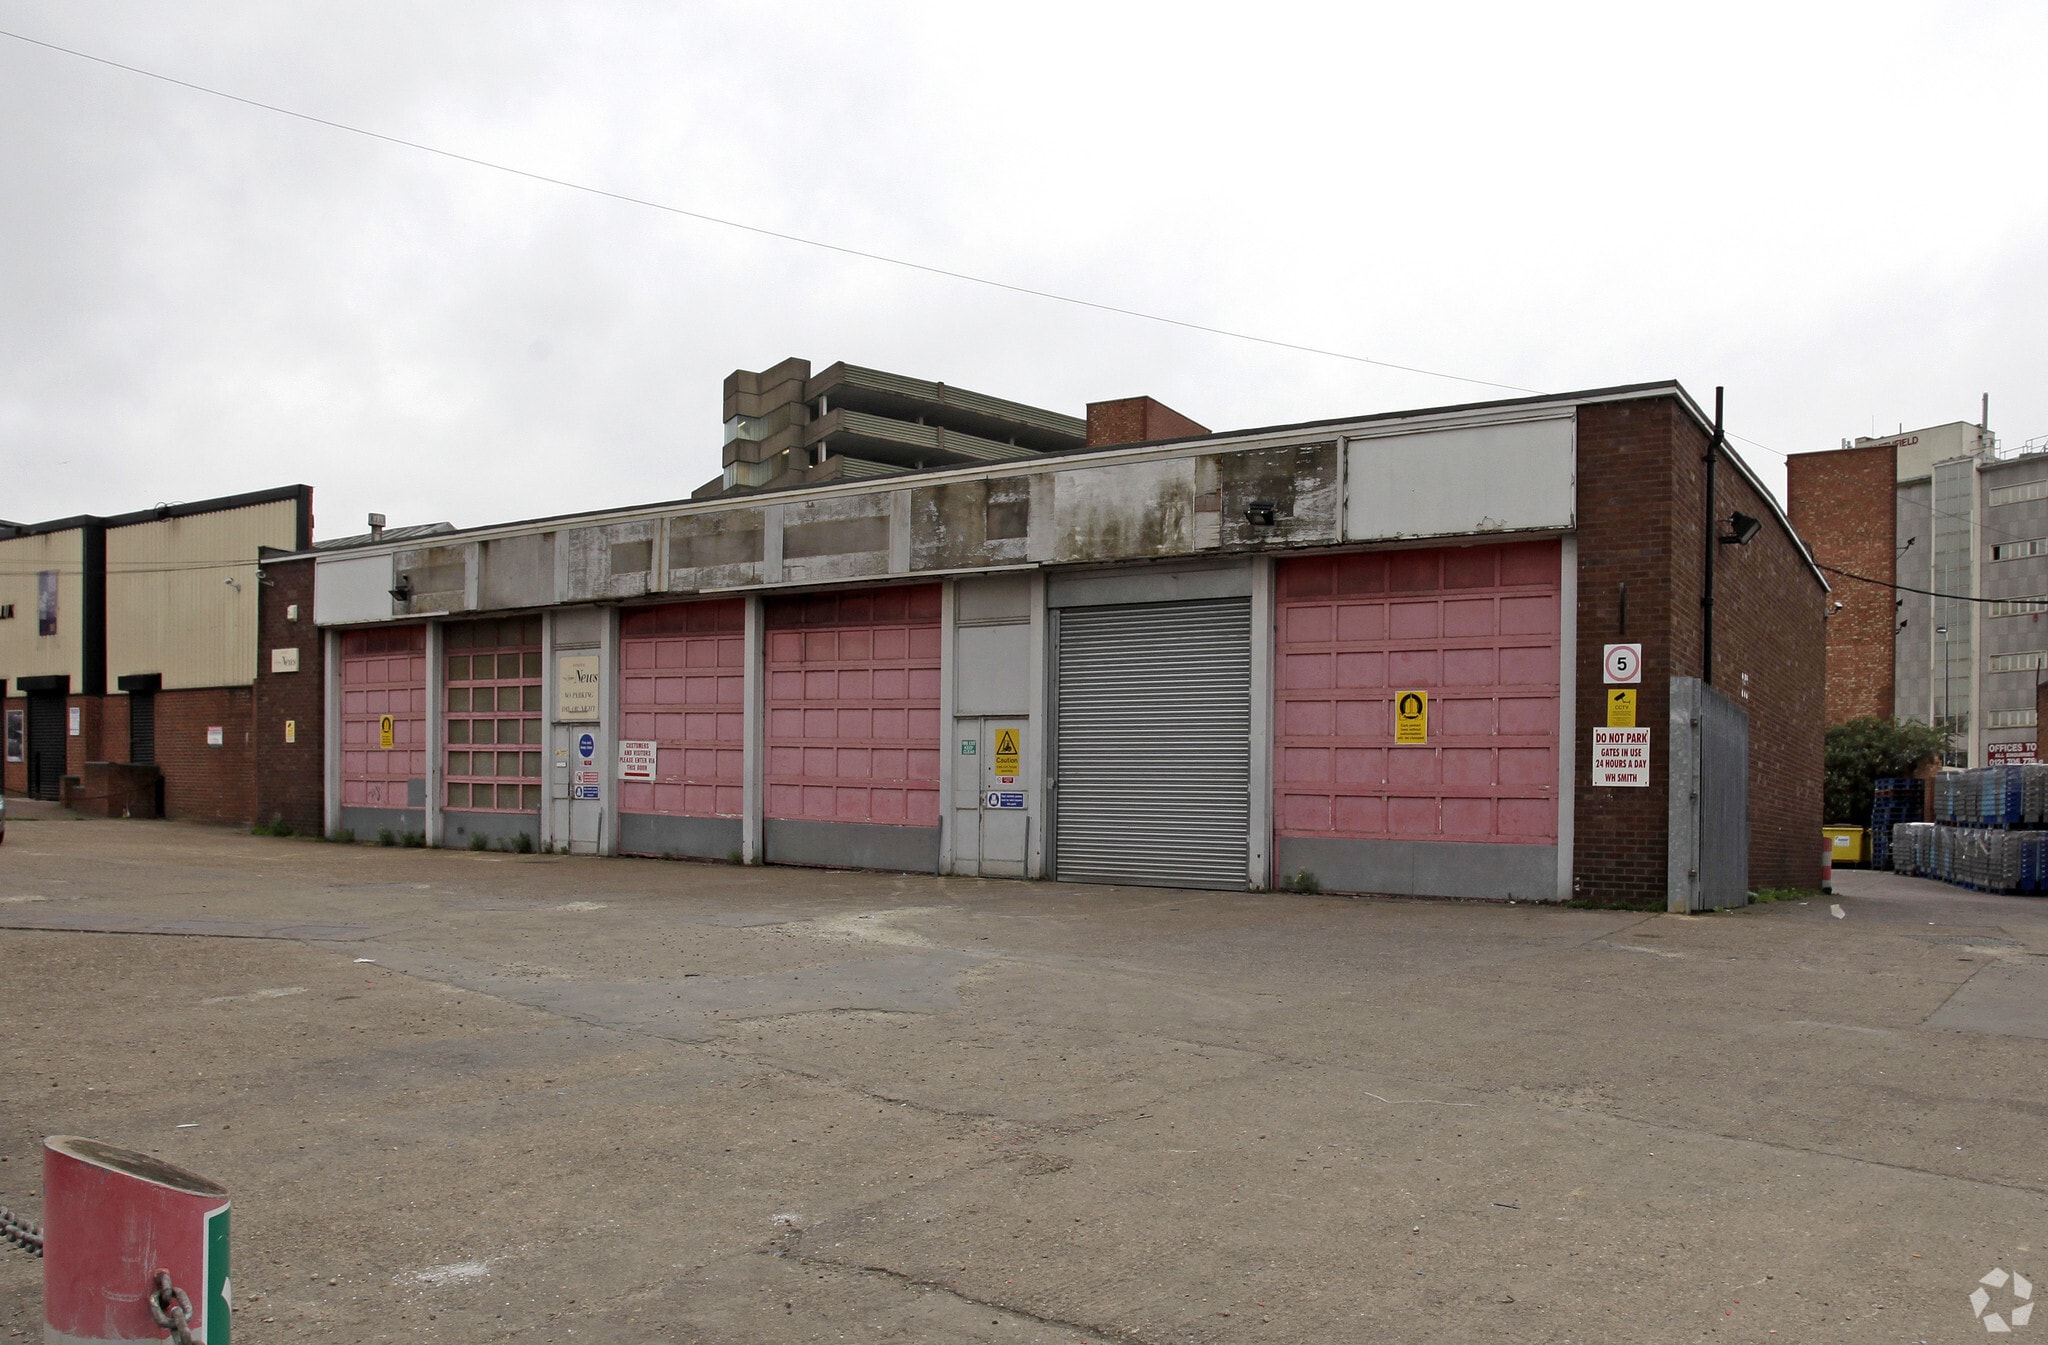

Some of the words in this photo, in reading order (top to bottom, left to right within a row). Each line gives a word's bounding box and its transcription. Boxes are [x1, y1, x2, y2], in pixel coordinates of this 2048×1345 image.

[1617, 657, 1627, 671] 5
[574, 669, 599, 684] News
[1596, 732, 1607, 743] DO
[1609, 732, 1625, 743] NOT
[1627, 732, 1648, 743] PARK
[1989, 744, 2023, 752] OFFICES
[2025, 743, 2037, 751] TO
[1601, 748, 1620, 757] GATES
[1621, 748, 1629, 757] IN
[1630, 748, 1642, 757] USE
[1595, 759, 1604, 768] 24
[1605, 759, 1627, 768] HOURS
[1628, 759, 1633, 768] A
[1634, 759, 1647, 768] DAY
[1605, 773, 1616, 782] WH
[1617, 773, 1638, 782] SMITH
